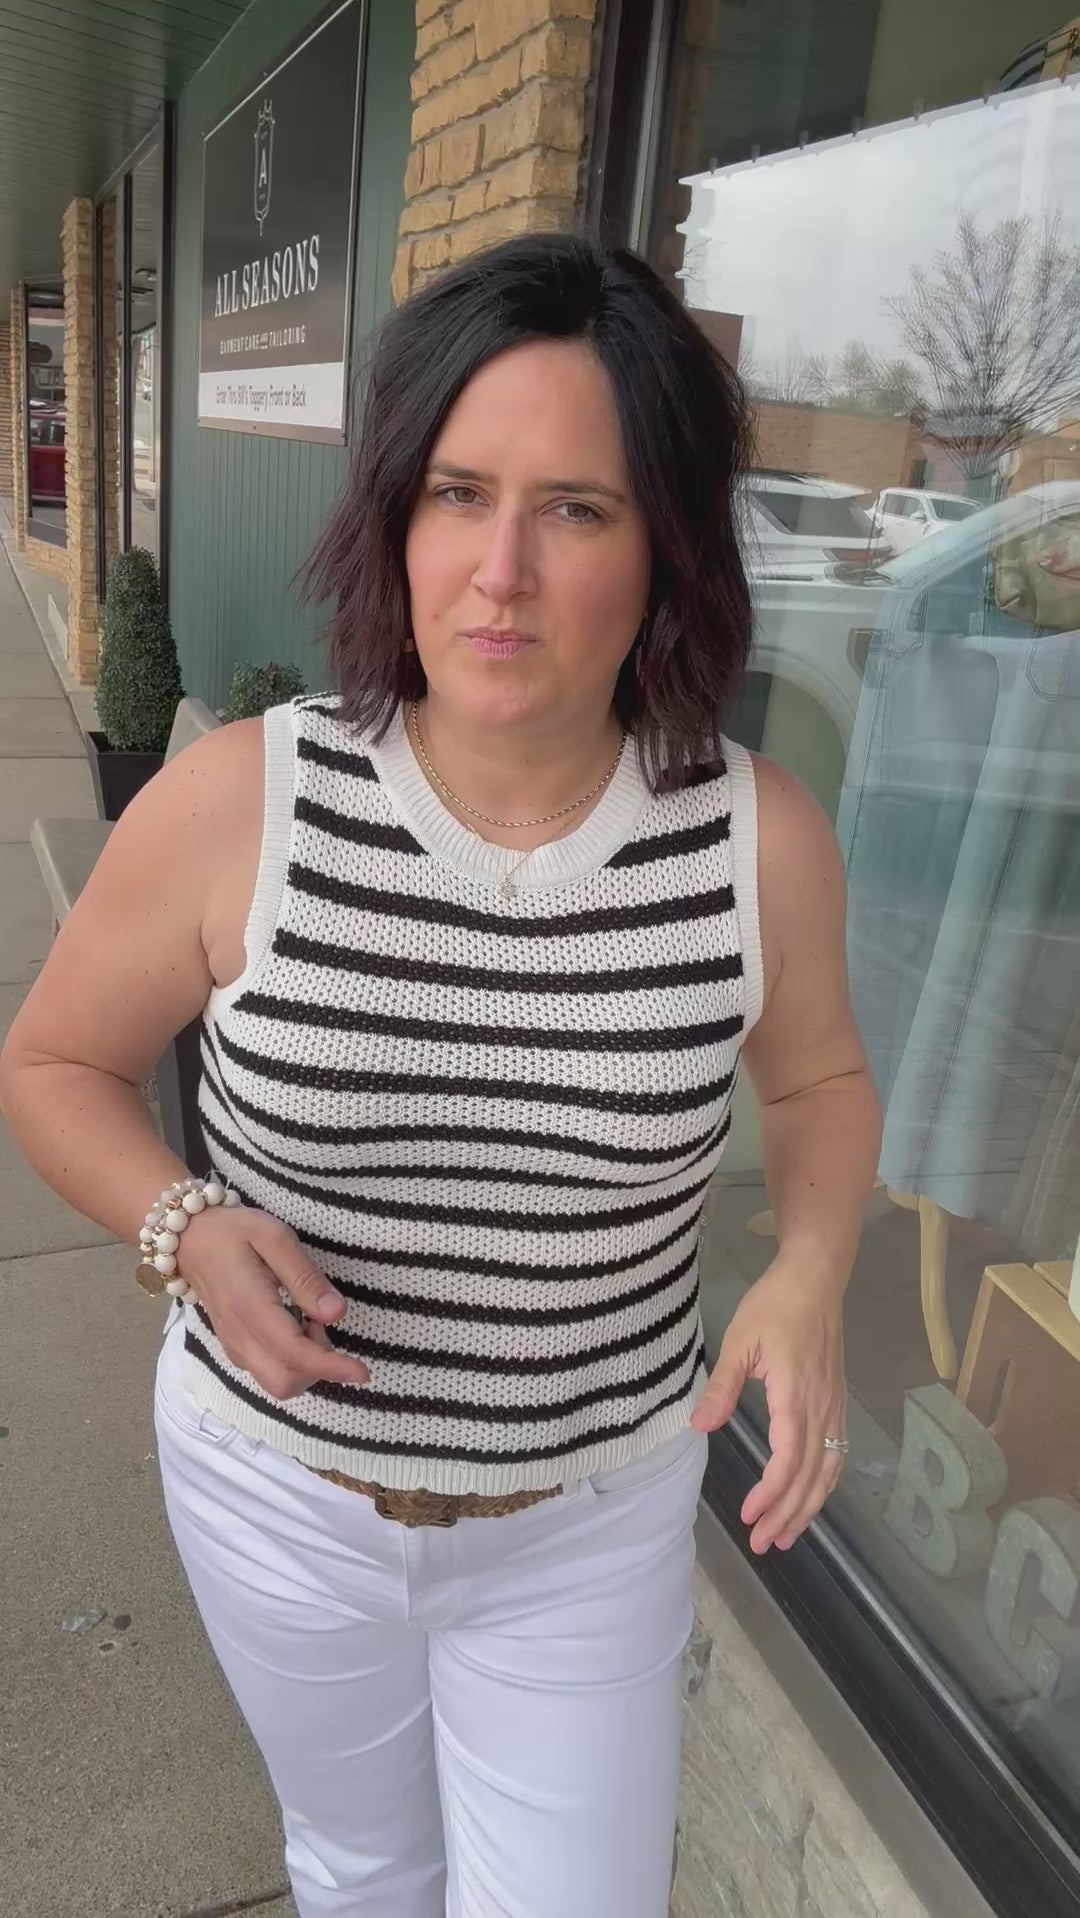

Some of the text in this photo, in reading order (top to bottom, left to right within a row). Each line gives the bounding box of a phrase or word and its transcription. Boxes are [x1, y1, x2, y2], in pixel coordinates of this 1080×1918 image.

[259, 147, 267, 187] A
[214, 234, 319, 317] ALL SEASONS
[220, 337, 243, 355] GARMENT
[244, 334, 260, 351] CARE
[269, 324, 306, 348] TAILORING
[292, 382, 306, 408] Back
